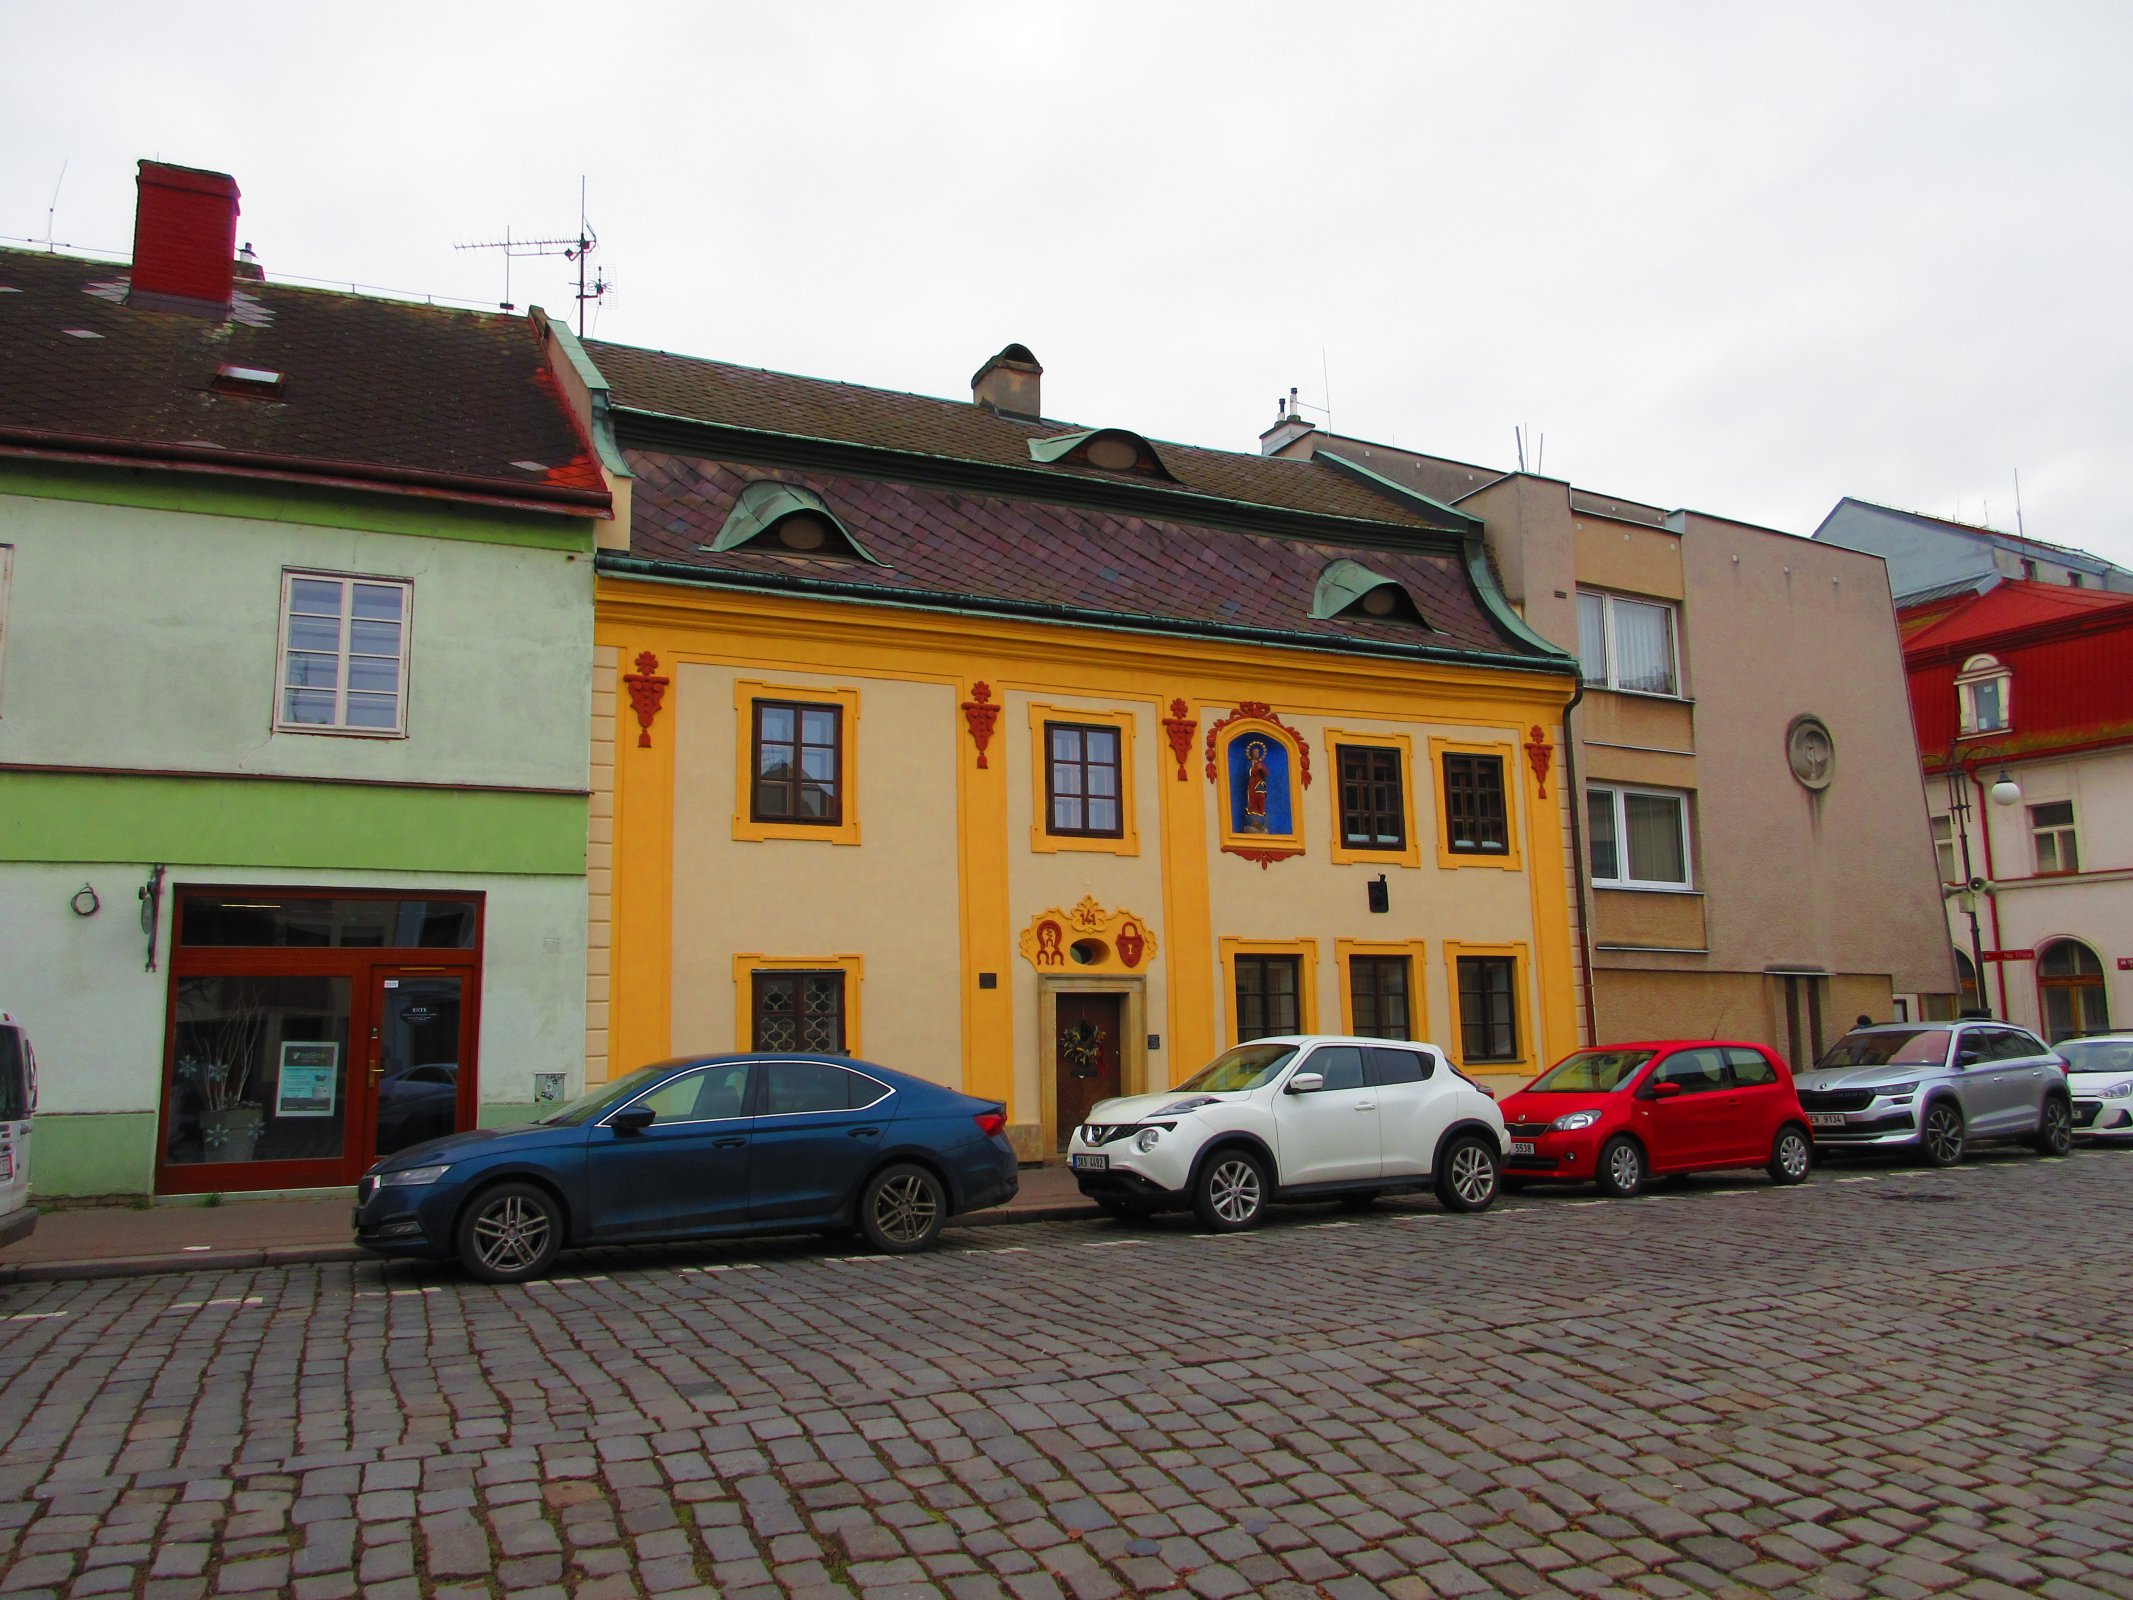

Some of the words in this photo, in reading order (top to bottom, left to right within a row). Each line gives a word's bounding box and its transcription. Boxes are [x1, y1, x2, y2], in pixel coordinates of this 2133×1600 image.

[1080, 909, 1096, 925] 141
[1824, 1115, 1841, 1123] 9134
[1515, 1143, 1532, 1153] 5538
[1090, 1157, 1103, 1168] 4492
